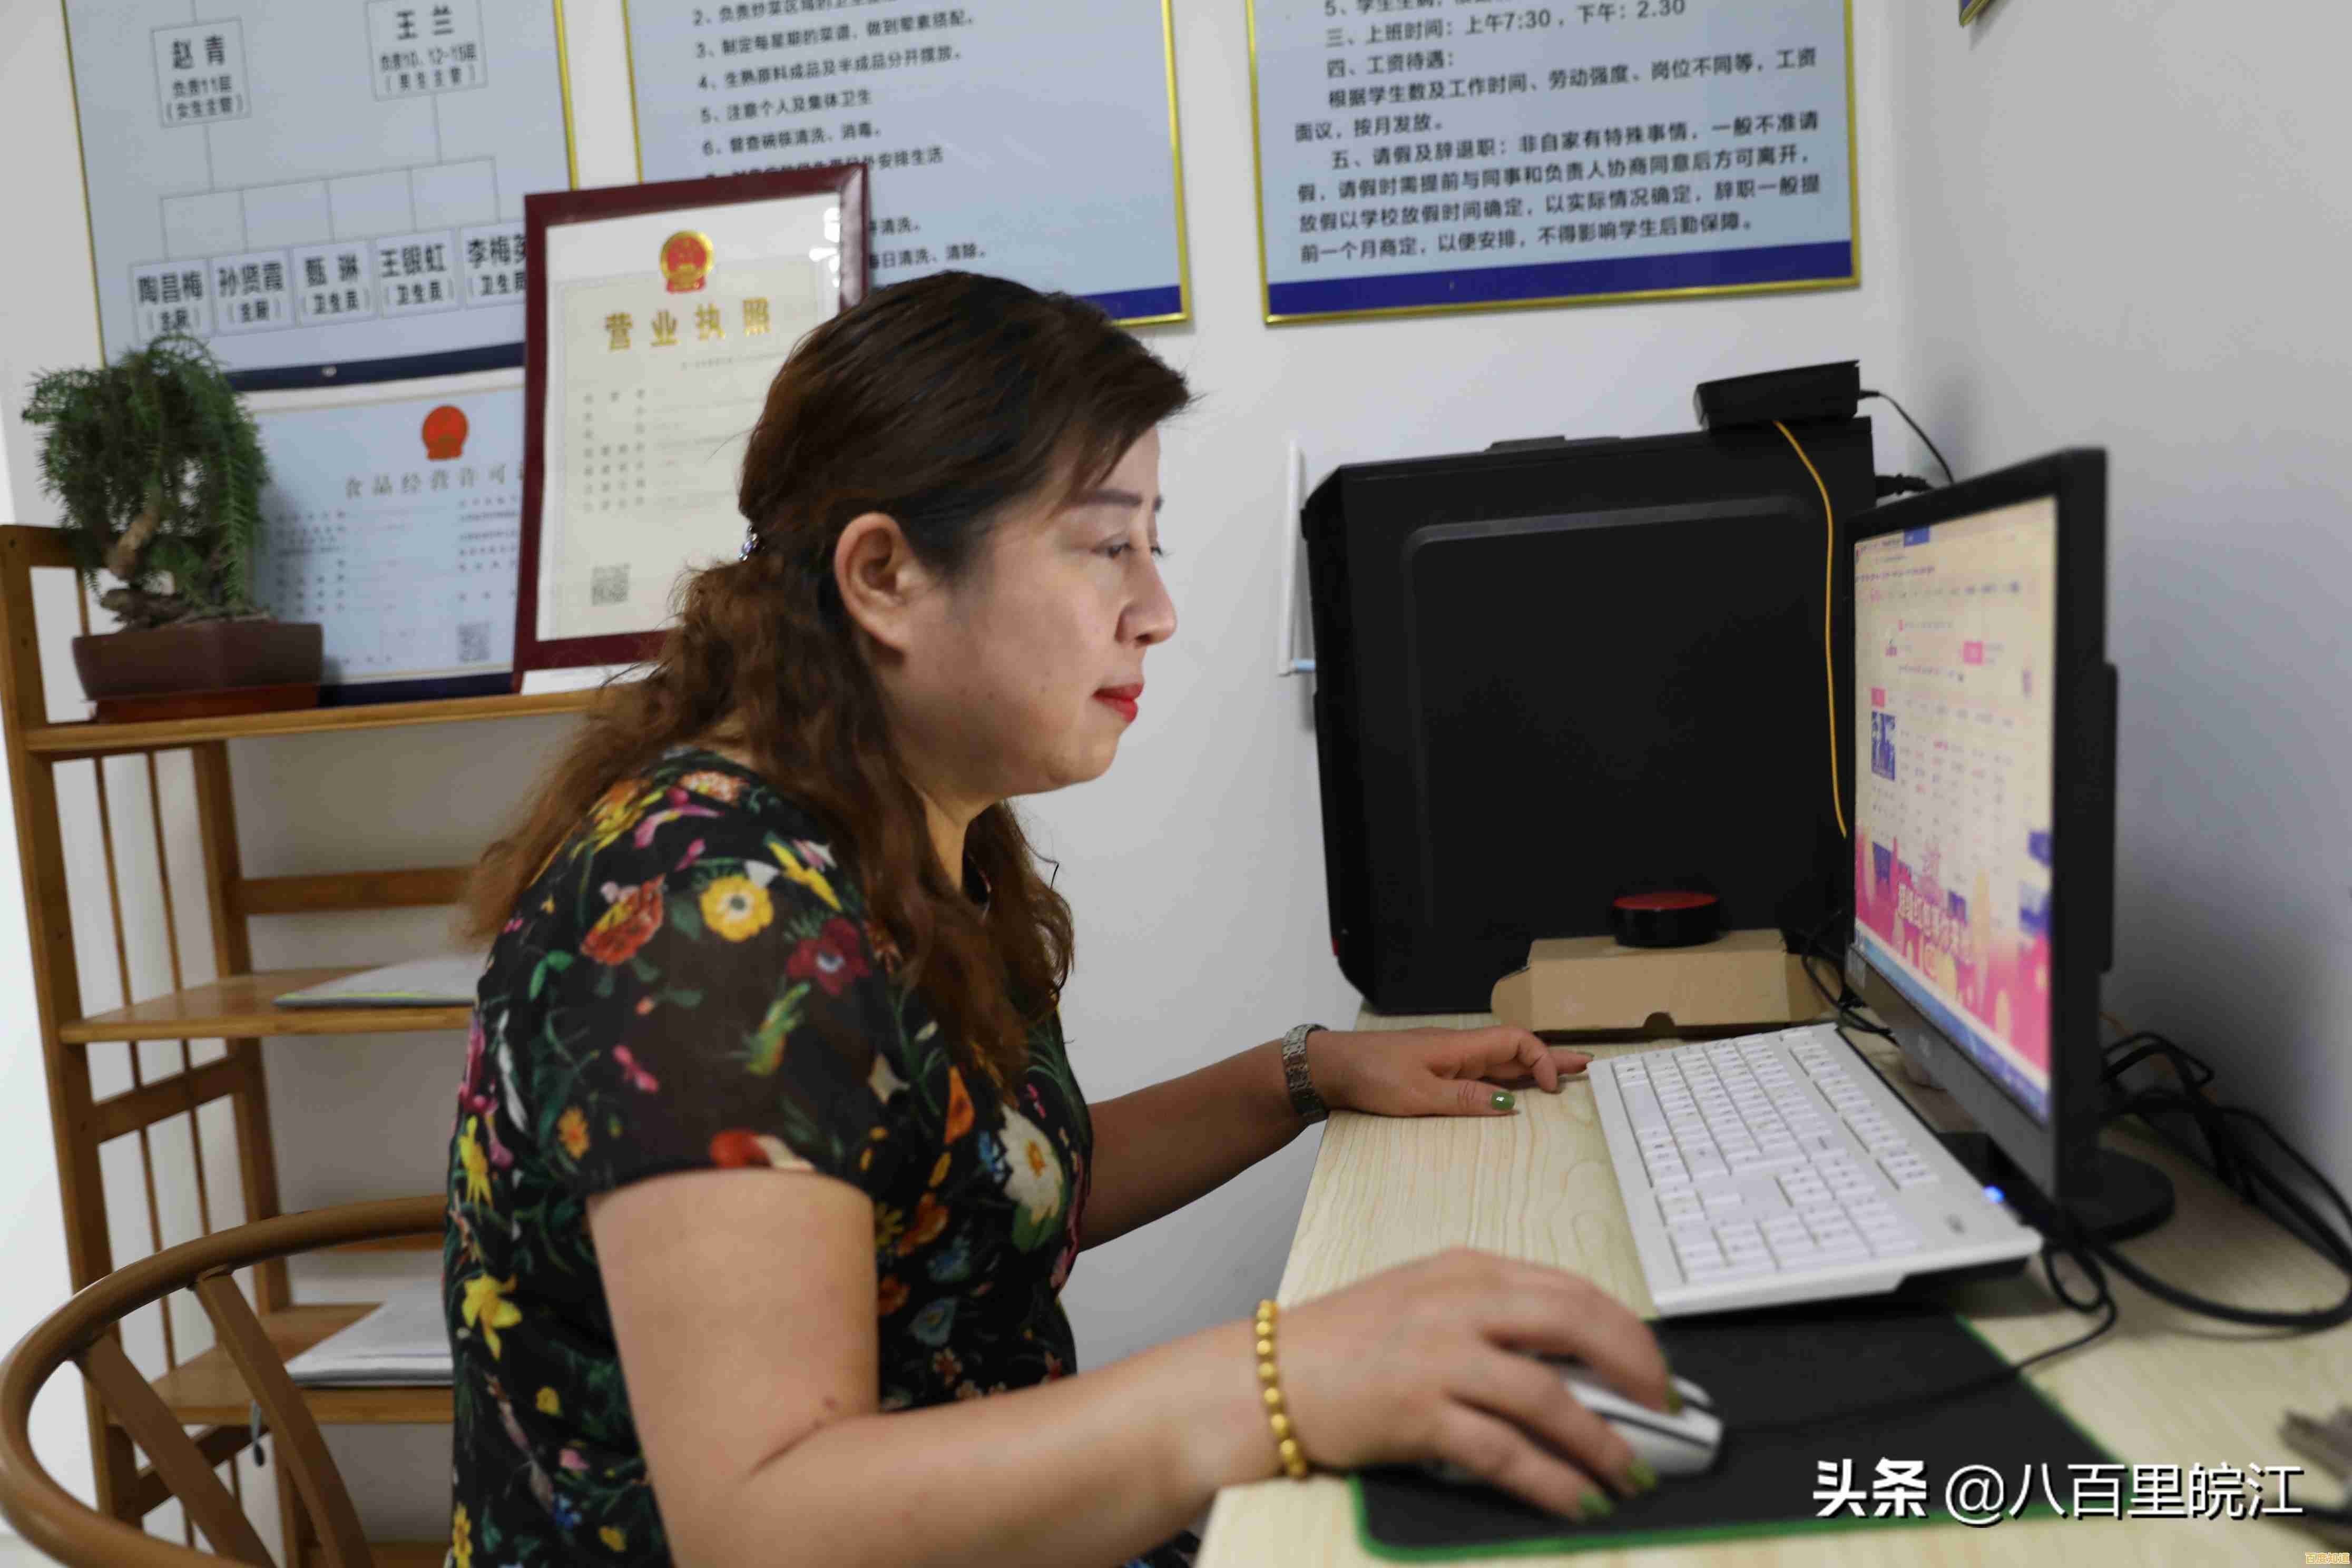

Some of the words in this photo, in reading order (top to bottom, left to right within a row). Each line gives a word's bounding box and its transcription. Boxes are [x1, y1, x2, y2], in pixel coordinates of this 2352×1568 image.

[397, 5, 454, 41] 王兰
[173, 35, 226, 70] 赵青
[605, 297, 772, 352] 营业执照
